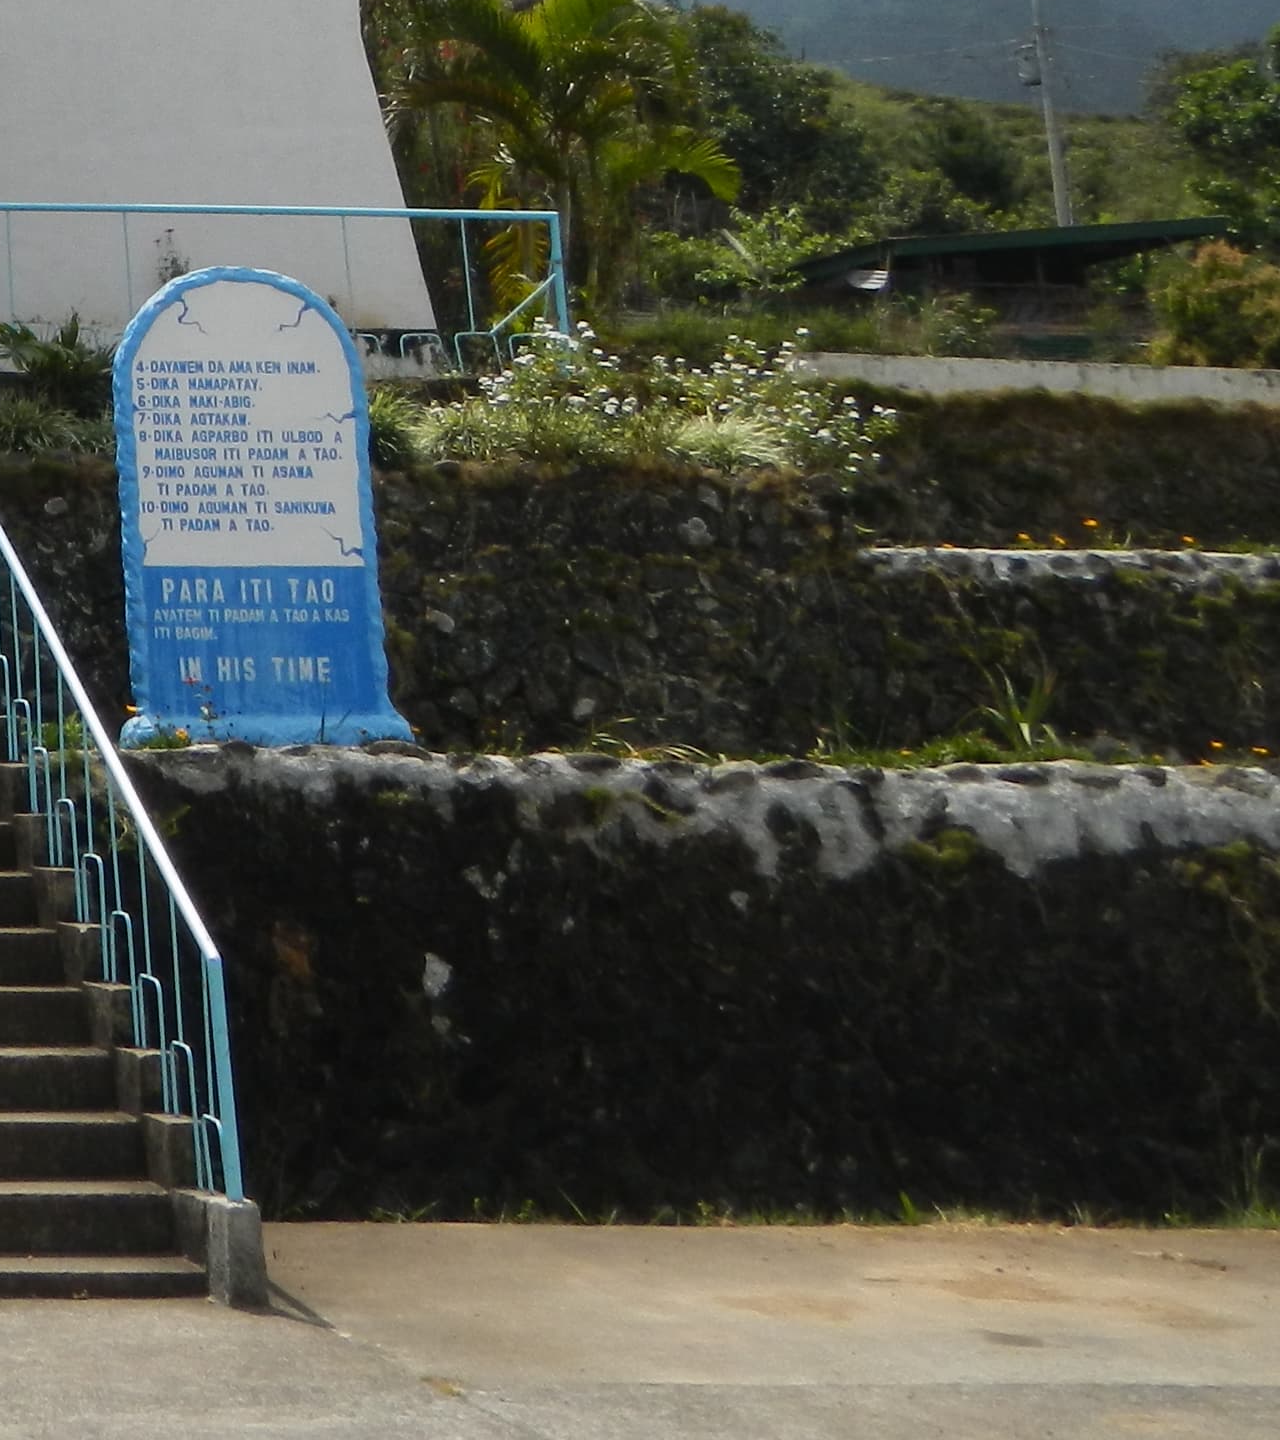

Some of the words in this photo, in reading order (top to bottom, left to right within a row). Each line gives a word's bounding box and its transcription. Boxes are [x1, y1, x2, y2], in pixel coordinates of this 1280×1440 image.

[208, 361, 225, 373] DA
[229, 361, 253, 373] AMA
[256, 361, 281, 374] KEN
[192, 431, 248, 443] AGPARBO
[257, 431, 273, 443] ITI
[282, 431, 323, 444] ULBOD
[334, 432, 342, 444] A
[155, 449, 217, 461] MAIBUSOR
[224, 449, 240, 461] ITI
[298, 448, 307, 461] A
[314, 448, 342, 461] TAO.
[253, 466, 264, 478] TI
[272, 466, 313, 478] ASAWA
[157, 484, 169, 496] TI
[226, 484, 234, 496] A
[256, 502, 267, 513] TI
[162, 520, 173, 531] TI
[229, 519, 237, 531] A
[162, 578, 225, 604] PARA
[240, 578, 272, 604] ITI
[288, 578, 336, 604] TAO
[209, 610, 220, 623] TI
[269, 610, 278, 623] A
[284, 609, 308, 623] TAO
[312, 610, 320, 623] A
[325, 609, 350, 622] KAS
[154, 627, 170, 640] ITI
[179, 657, 203, 682] IN
[218, 657, 257, 682] HIS
[272, 657, 332, 683] TIME
